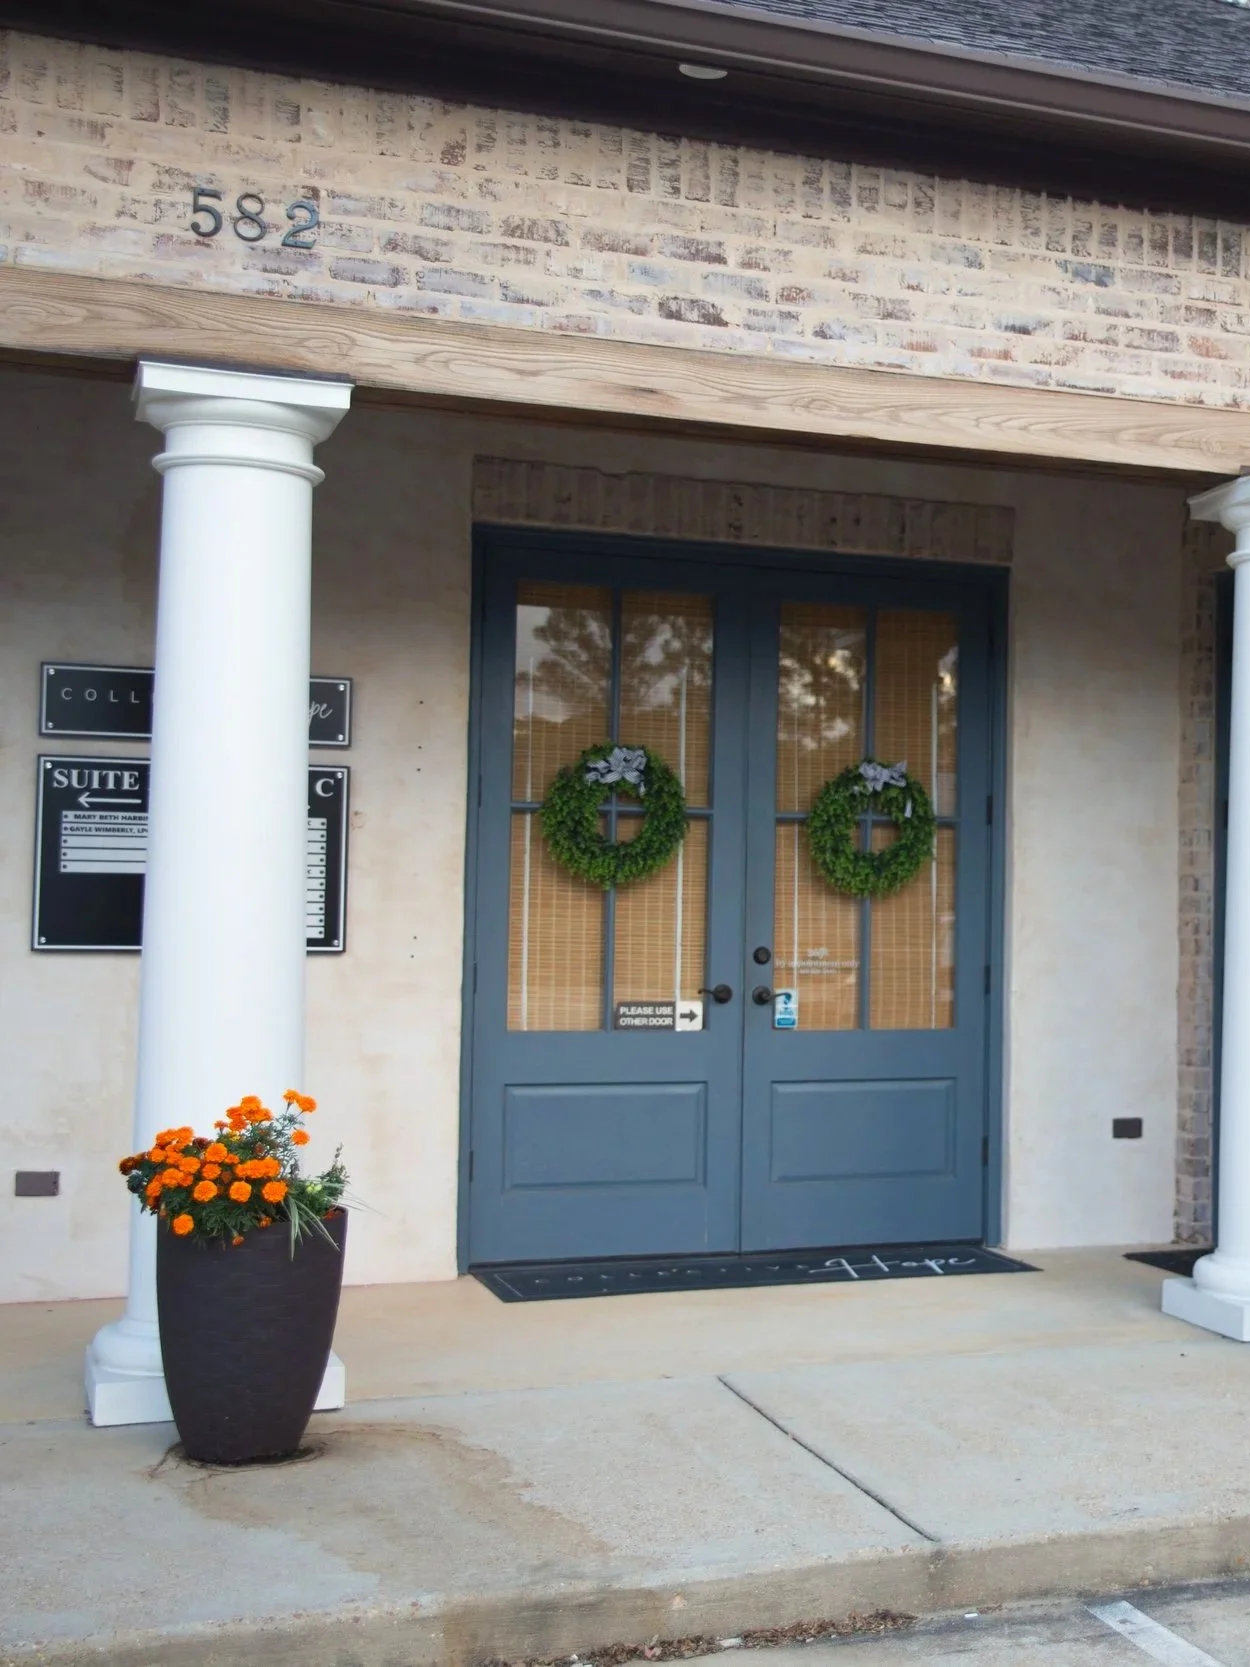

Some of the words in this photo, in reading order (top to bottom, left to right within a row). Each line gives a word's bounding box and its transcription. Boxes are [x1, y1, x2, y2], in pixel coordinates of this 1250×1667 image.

[190, 186, 320, 250] 582
[52, 768, 141, 791] SUITE
[315, 778, 335, 798] C
[73, 813, 98, 821] MARY
[619, 1006, 654, 1015] PLEASE
[655, 1006, 674, 1015] USE
[619, 1017, 648, 1026] OTHER
[648, 1017, 674, 1026] DOOR
[808, 1254, 976, 1279] Hope
